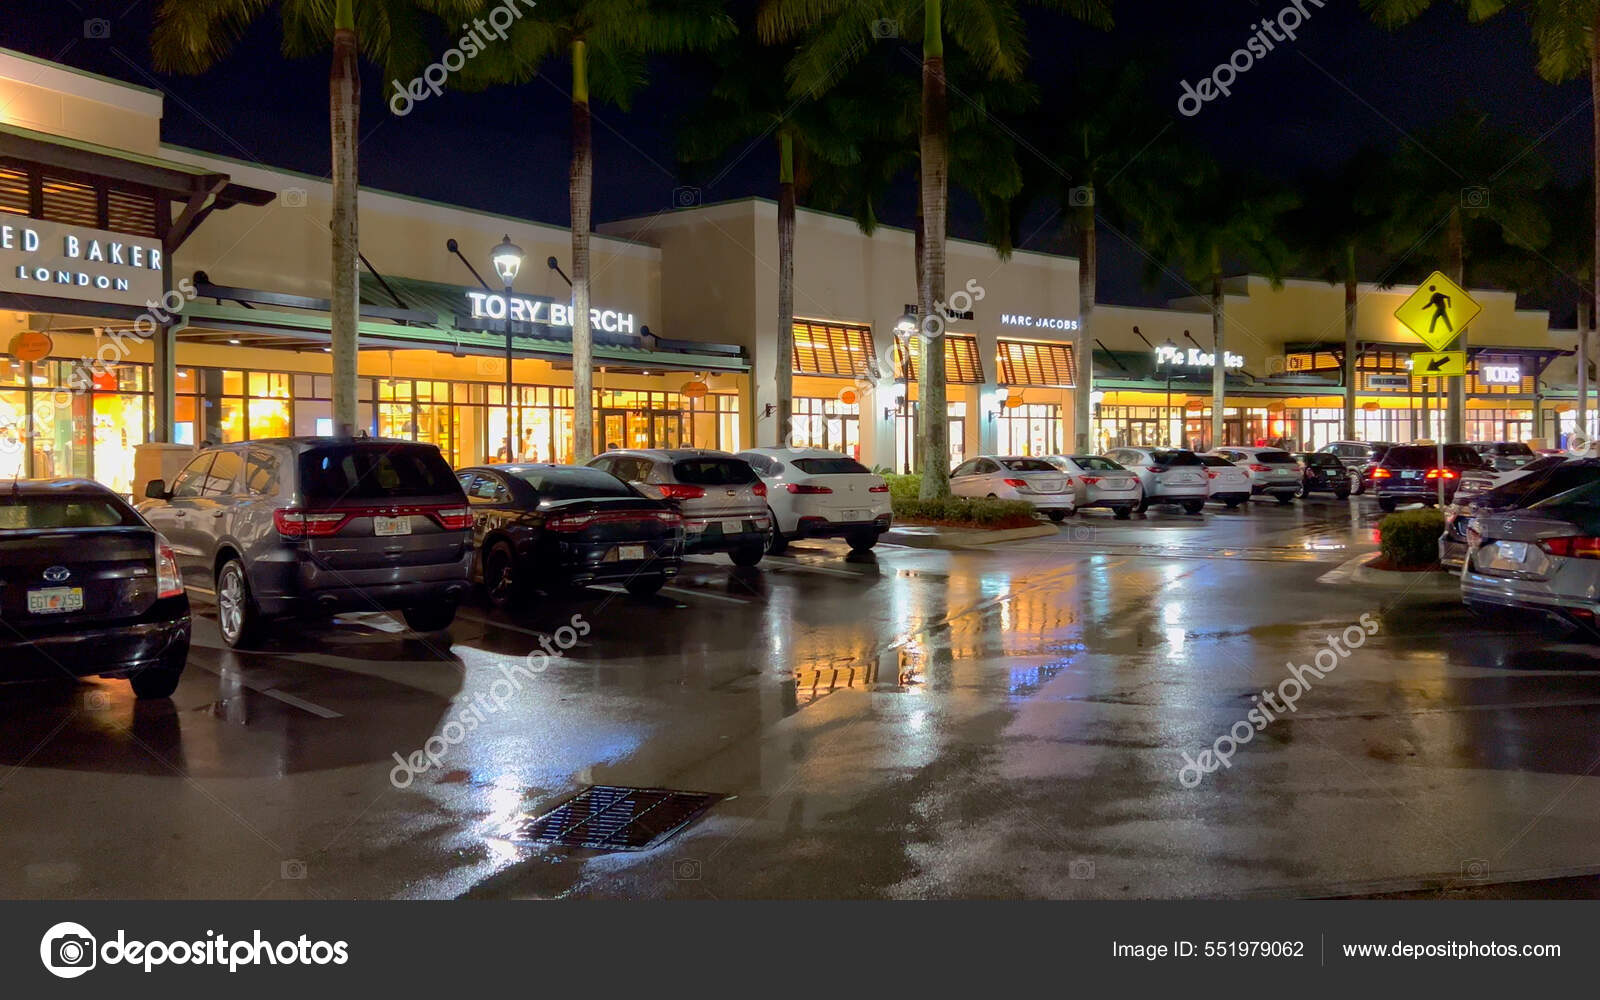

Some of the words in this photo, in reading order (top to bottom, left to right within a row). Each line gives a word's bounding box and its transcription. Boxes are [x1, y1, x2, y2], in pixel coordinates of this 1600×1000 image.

[64, 235, 161, 270] BAKER
[17, 265, 129, 291] LONDON
[466, 291, 541, 322] TORY
[1001, 314, 1032, 326] MARC
[1035, 318, 1078, 330] JACOBS
